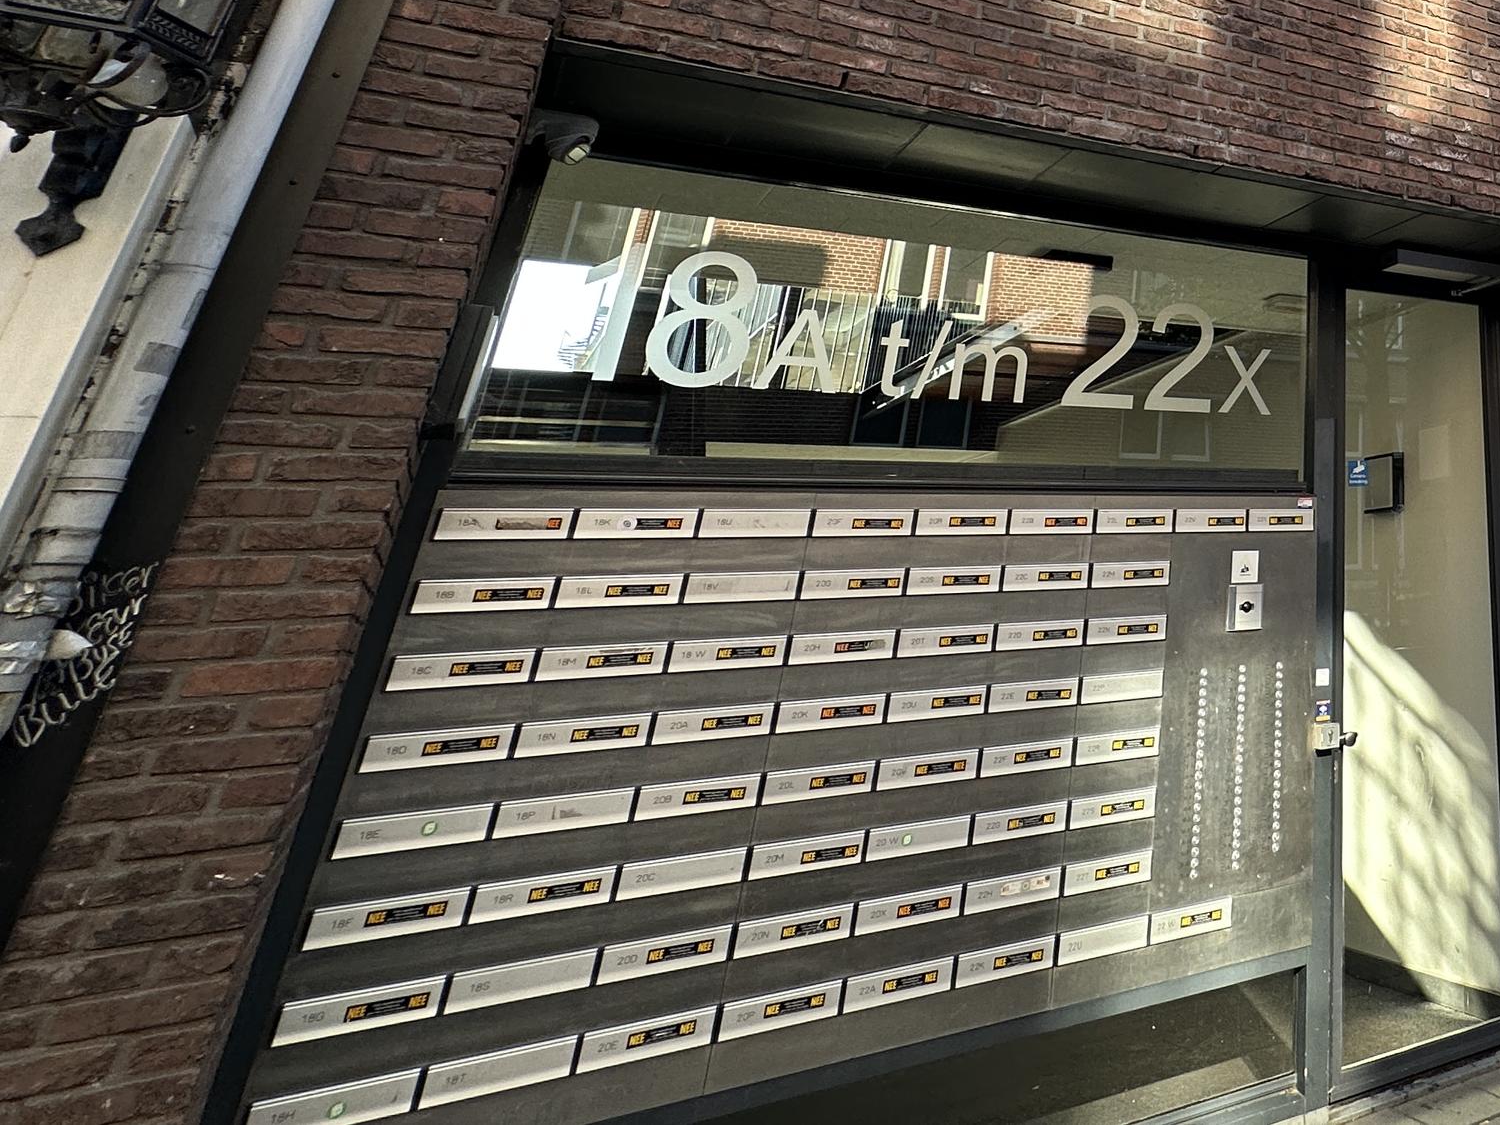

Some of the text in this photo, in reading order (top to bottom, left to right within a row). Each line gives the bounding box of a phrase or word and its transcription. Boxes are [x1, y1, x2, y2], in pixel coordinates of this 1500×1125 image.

[585, 251, 838, 394] 18A
[880, 318, 1029, 404] t/m
[547, 520, 563, 528] NEE
[667, 518, 683, 527] NEE
[475, 590, 492, 600] NEE
[527, 590, 543, 599] NEE
[607, 587, 622, 596] NEE
[655, 585, 668, 595] NEE
[939, 634, 988, 645] NEE NEE
[718, 646, 776, 659] NEE NEE
[836, 643, 848, 652] NEE
[589, 656, 604, 666] NEE
[638, 654, 652, 663] NEE
[411, 666, 432, 675] 18C
[452, 664, 469, 674] NEE
[505, 661, 522, 672] NEE
[932, 694, 981, 707] NEE NEE
[821, 706, 876, 717] NEE NEE
[670, 721, 688, 730] 20A
[703, 716, 762, 729] NEE NEE
[573, 730, 590, 740] NEE
[623, 726, 638, 737] NEE
[424, 743, 442, 754] NEE
[479, 737, 497, 748] NEE
[915, 762, 966, 775] NEE NEE
[811, 774, 865, 788] NEE NEE
[685, 789, 745, 802] NEE NEE
[515, 811, 535, 820] 18P
[360, 828, 382, 840] 18E
[803, 847, 857, 861] NEE NEE
[530, 890, 547, 900] NEE
[583, 881, 599, 892] NEE
[493, 894, 514, 904] 18R
[899, 897, 950, 916] NEE NEE
[368, 913, 386, 924] NEE
[426, 904, 444, 915] NEE
[330, 916, 354, 928] 18F
[782, 920, 840, 937] NEE NEE
[648, 950, 665, 961] NEE
[698, 942, 713, 952] NEE
[617, 954, 638, 966] 20D
[470, 981, 491, 992] 18S
[884, 974, 937, 991] NEE NEE
[347, 1006, 366, 1019] NEE
[408, 995, 427, 1008] NEE
[766, 996, 825, 1016] NEE NEE
[629, 1023, 695, 1046] NEE NEE
